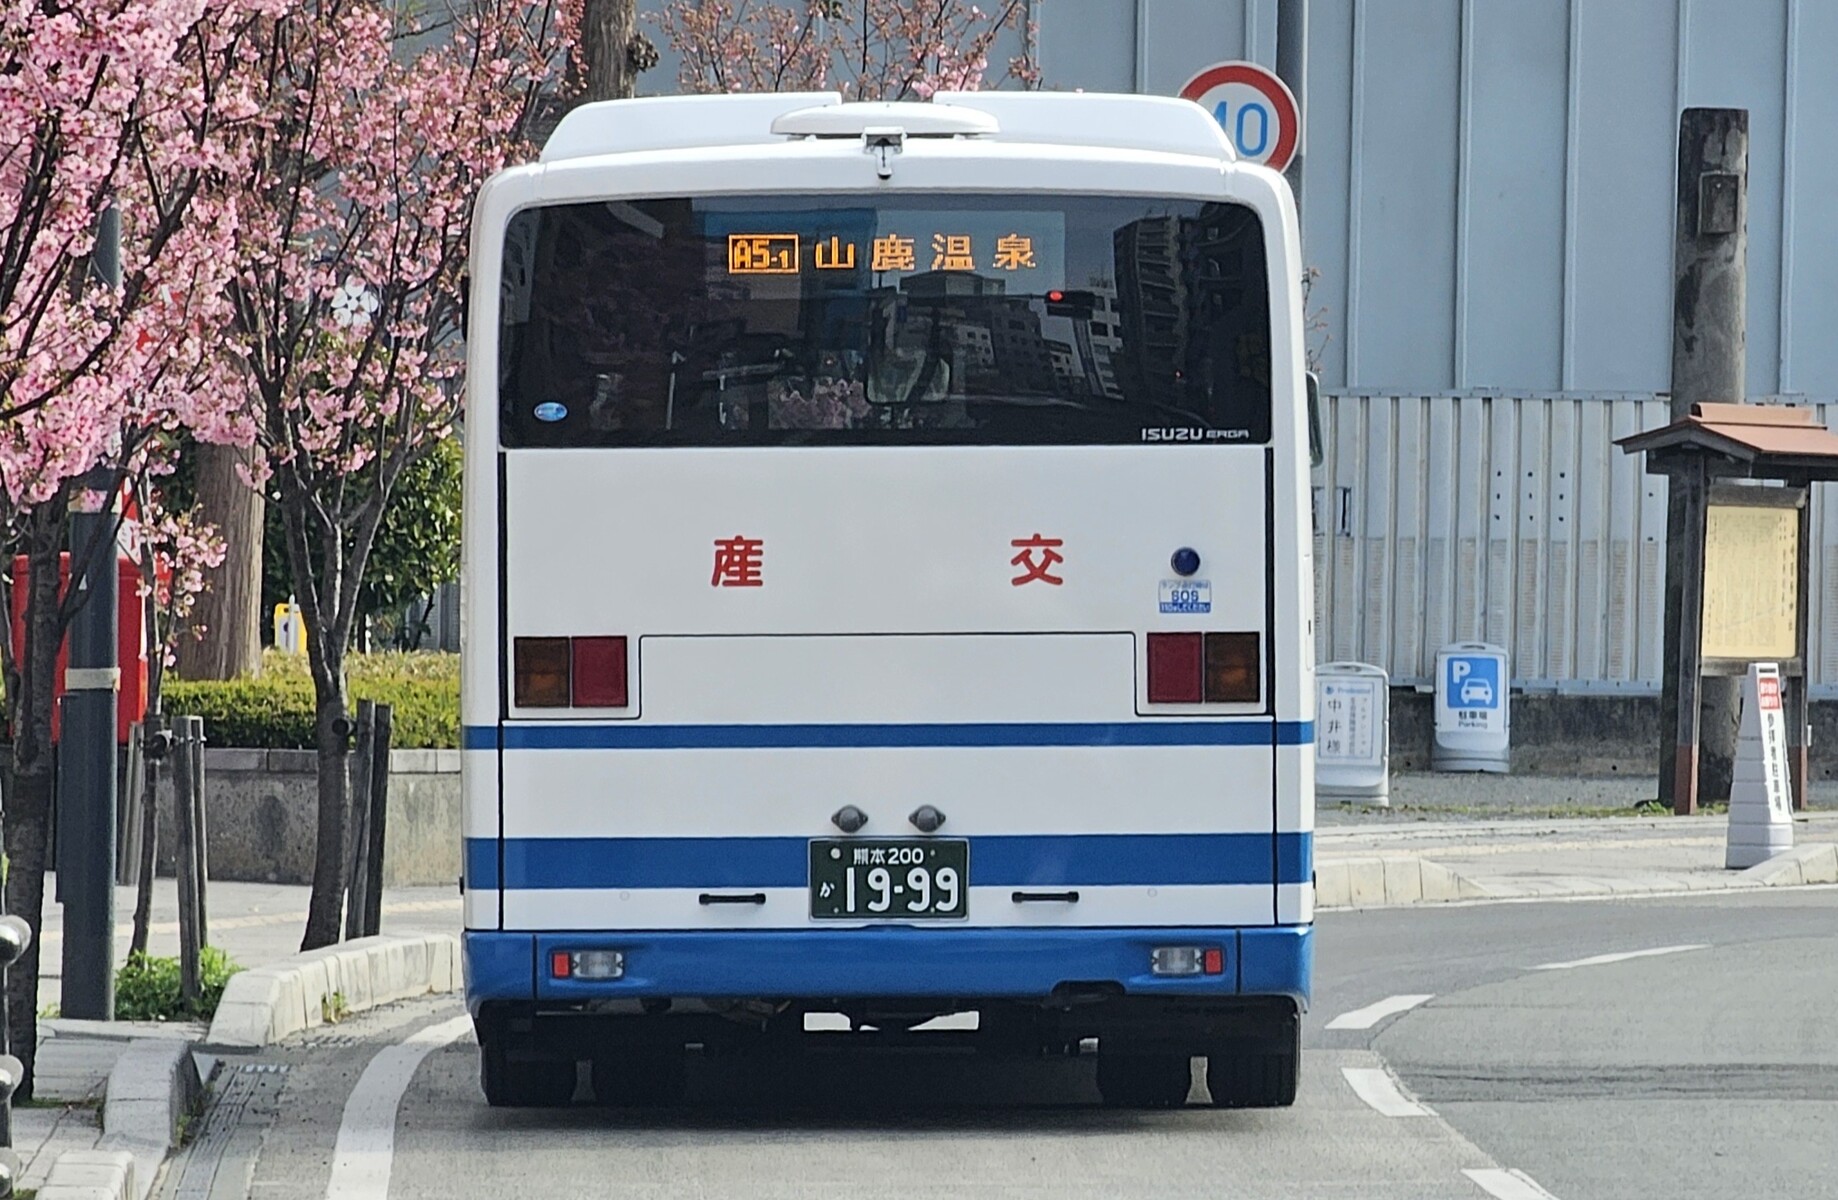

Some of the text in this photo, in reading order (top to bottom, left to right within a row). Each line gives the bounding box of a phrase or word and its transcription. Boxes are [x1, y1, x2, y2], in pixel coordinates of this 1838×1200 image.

[815, 233, 1037, 271] 山鹿温泉
[1141, 427, 1250, 441] ISUZU ERGA
[711, 533, 1063, 587] 産 交
[1453, 661, 1471, 684] P
[1326, 699, 1342, 754] 中井様
[1458, 720, 1488, 729] Parking
[819, 881, 835, 898] か
[846, 867, 959, 912] 19-99
